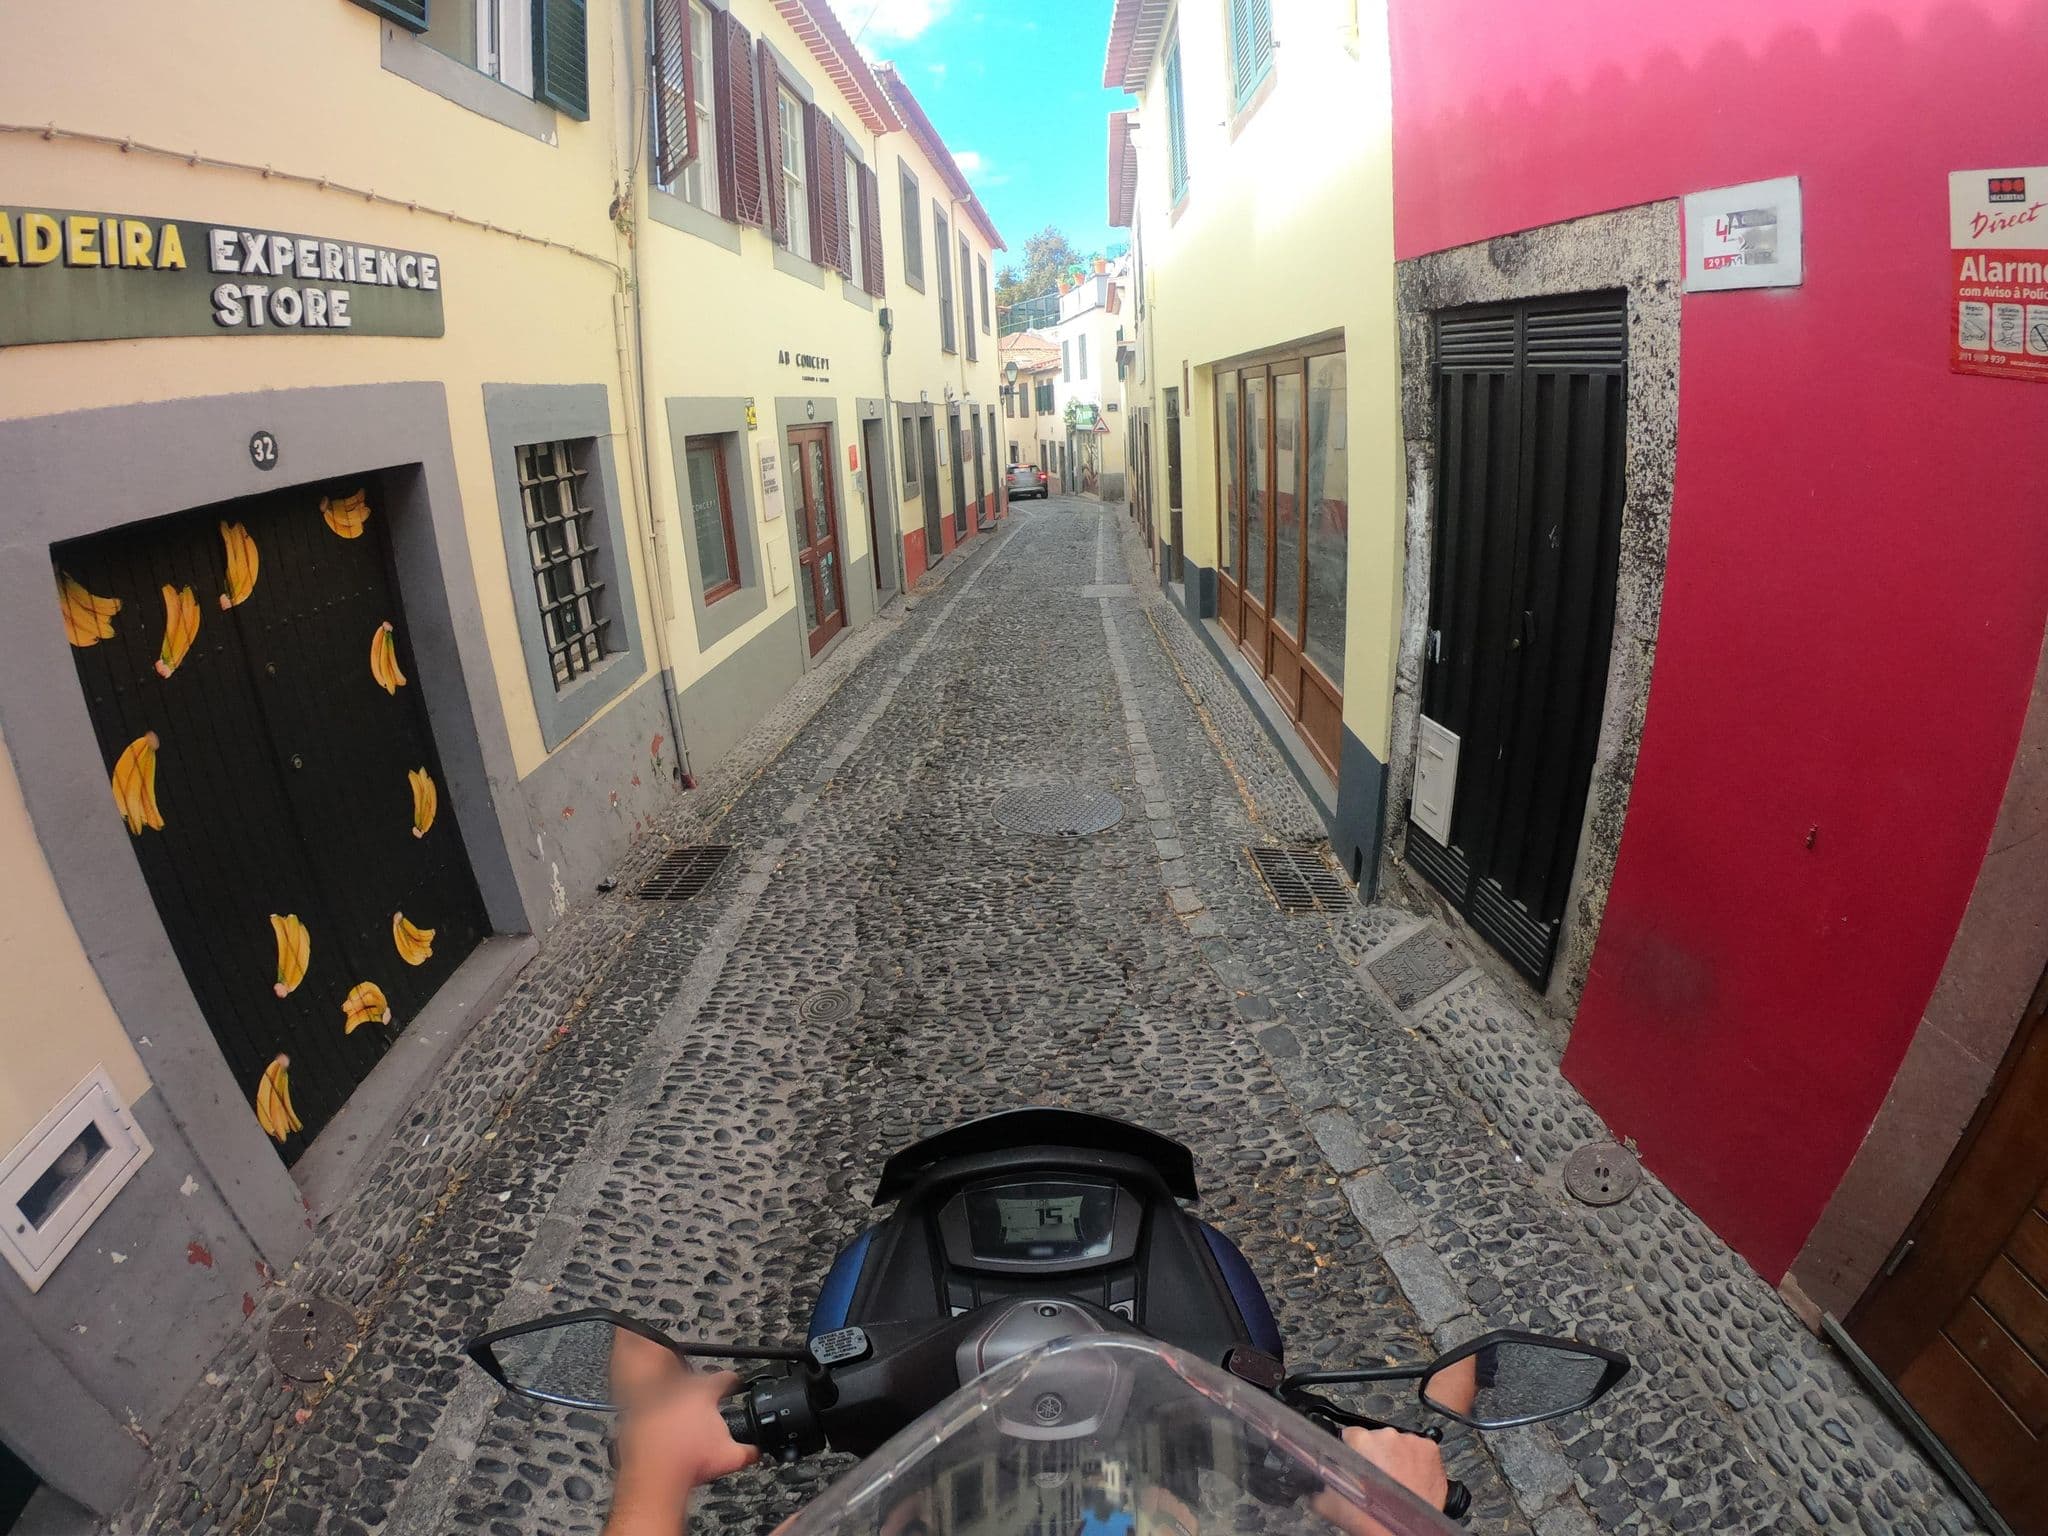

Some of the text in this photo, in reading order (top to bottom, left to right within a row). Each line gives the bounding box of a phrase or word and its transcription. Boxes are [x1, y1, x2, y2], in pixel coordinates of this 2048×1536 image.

[1970, 202, 2048, 239] Direct
[0, 211, 438, 290] ADEIRA EXPERIENCE
[1960, 255, 2048, 284] Alarm
[213, 283, 351, 327] STORE
[1960, 288, 1981, 297] com
[1983, 286, 2011, 298] Aviso
[796, 353, 829, 370] CONCEPT
[254, 437, 274, 462] 32
